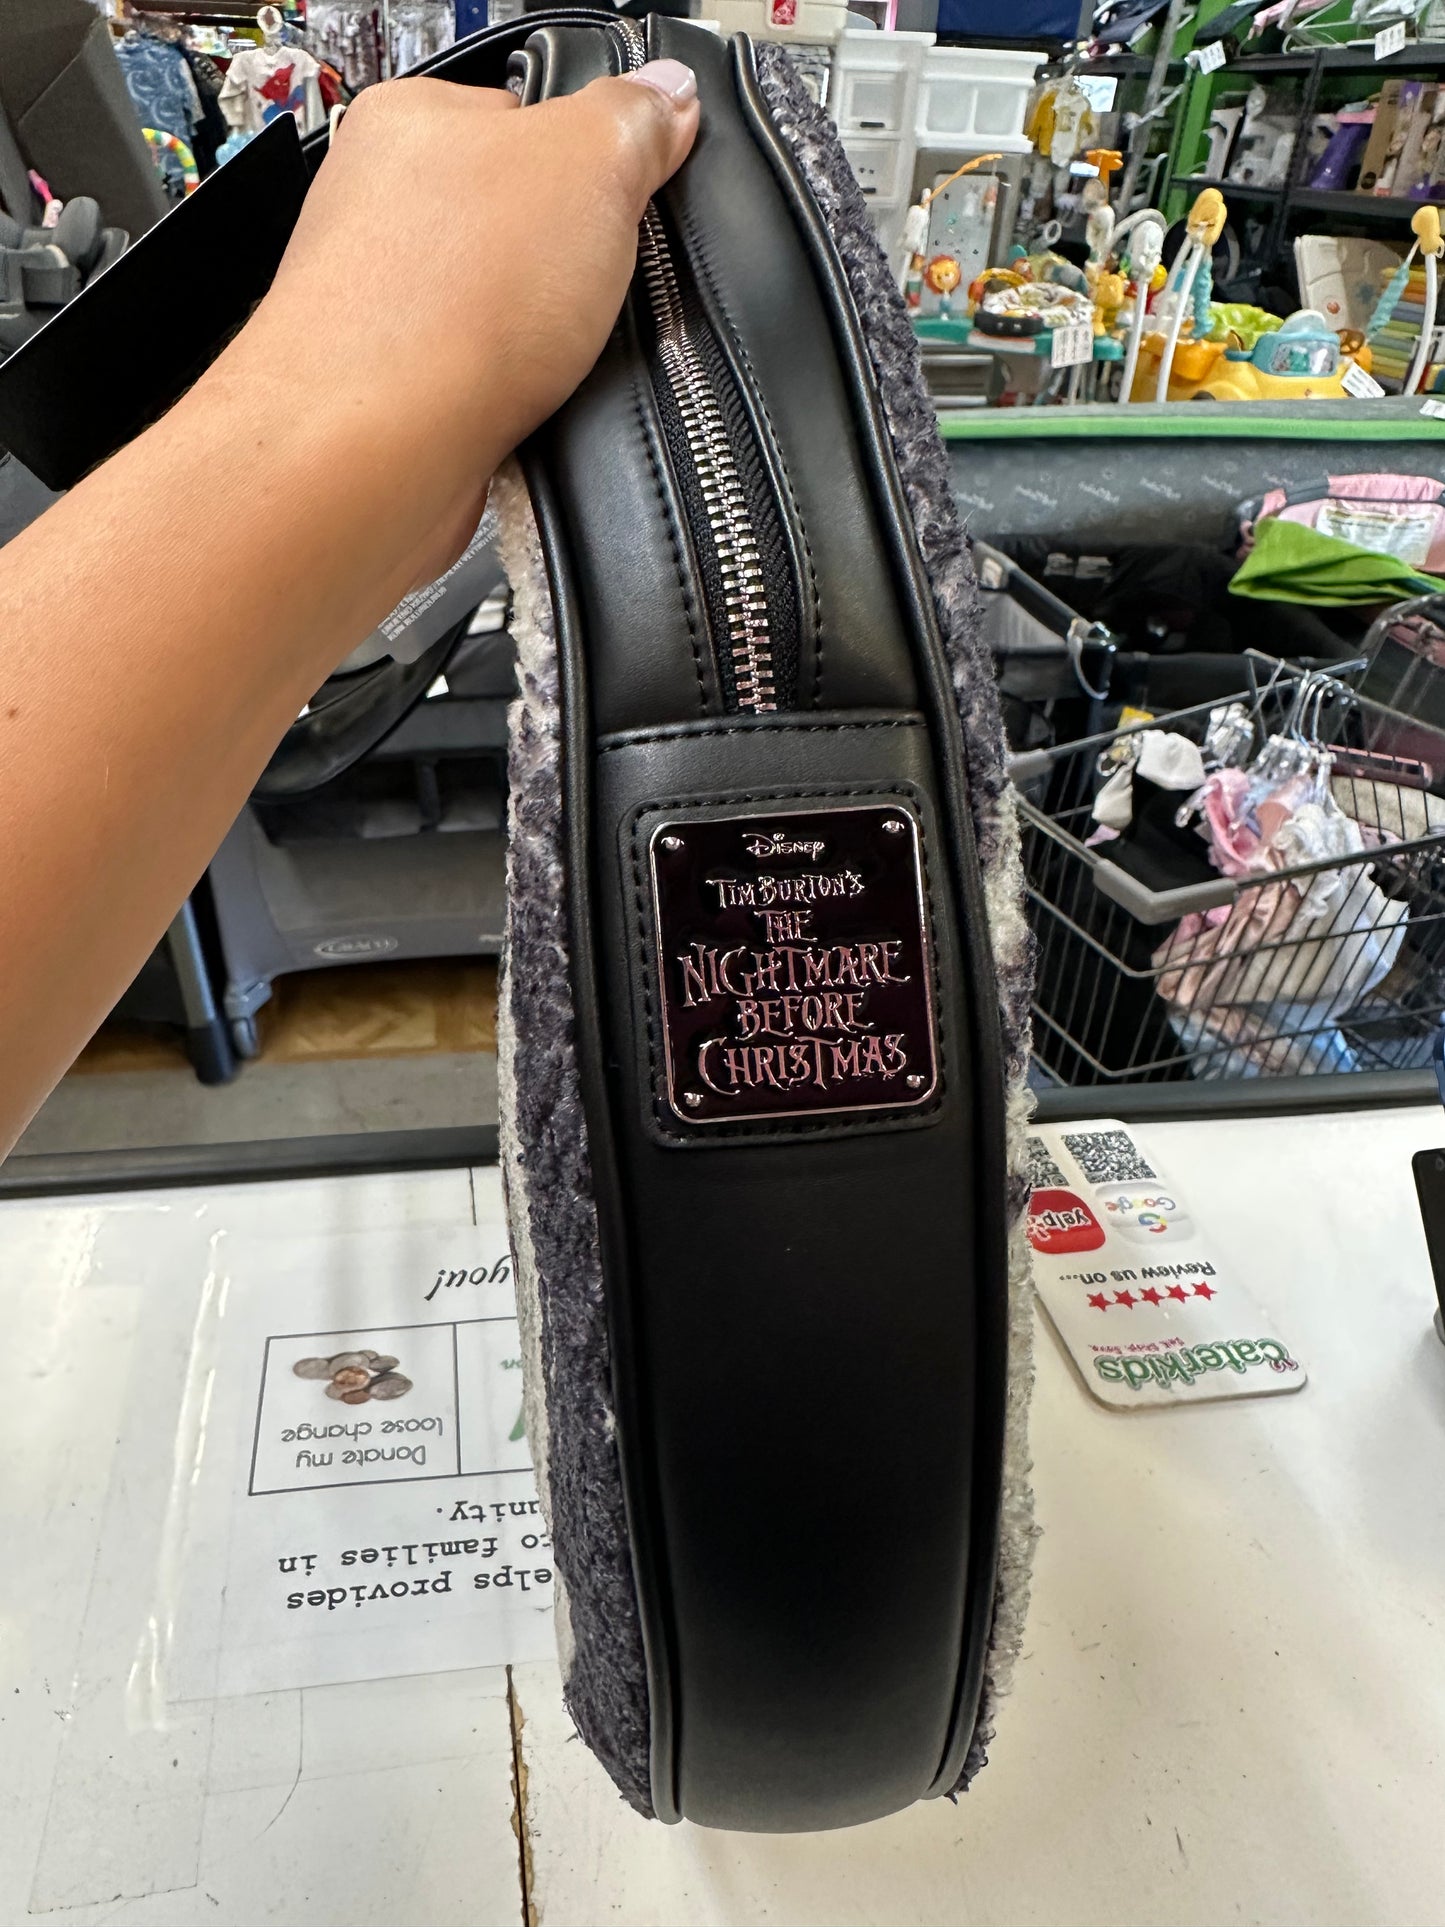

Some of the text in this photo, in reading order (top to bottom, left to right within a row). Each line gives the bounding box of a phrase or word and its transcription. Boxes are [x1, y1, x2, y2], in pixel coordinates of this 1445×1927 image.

[754, 909, 818, 943] THE
[677, 940, 911, 1008] NIGHTMARE
[736, 992, 875, 1040] BEFORE
[698, 1033, 908, 1095] CHRISTMAS
[1043, 1208, 1091, 1230] yelp
[1104, 1196, 1177, 1214] Google
[423, 1254, 512, 1301] you!
[1113, 1269, 1137, 1281] us
[1142, 1261, 1217, 1280] Review
[280, 1416, 443, 1443] loose change
[295, 1445, 427, 1468] Donate my
[278, 1553, 318, 1576] in
[341, 1536, 498, 1567] families
[286, 1565, 552, 1610] elps provides
